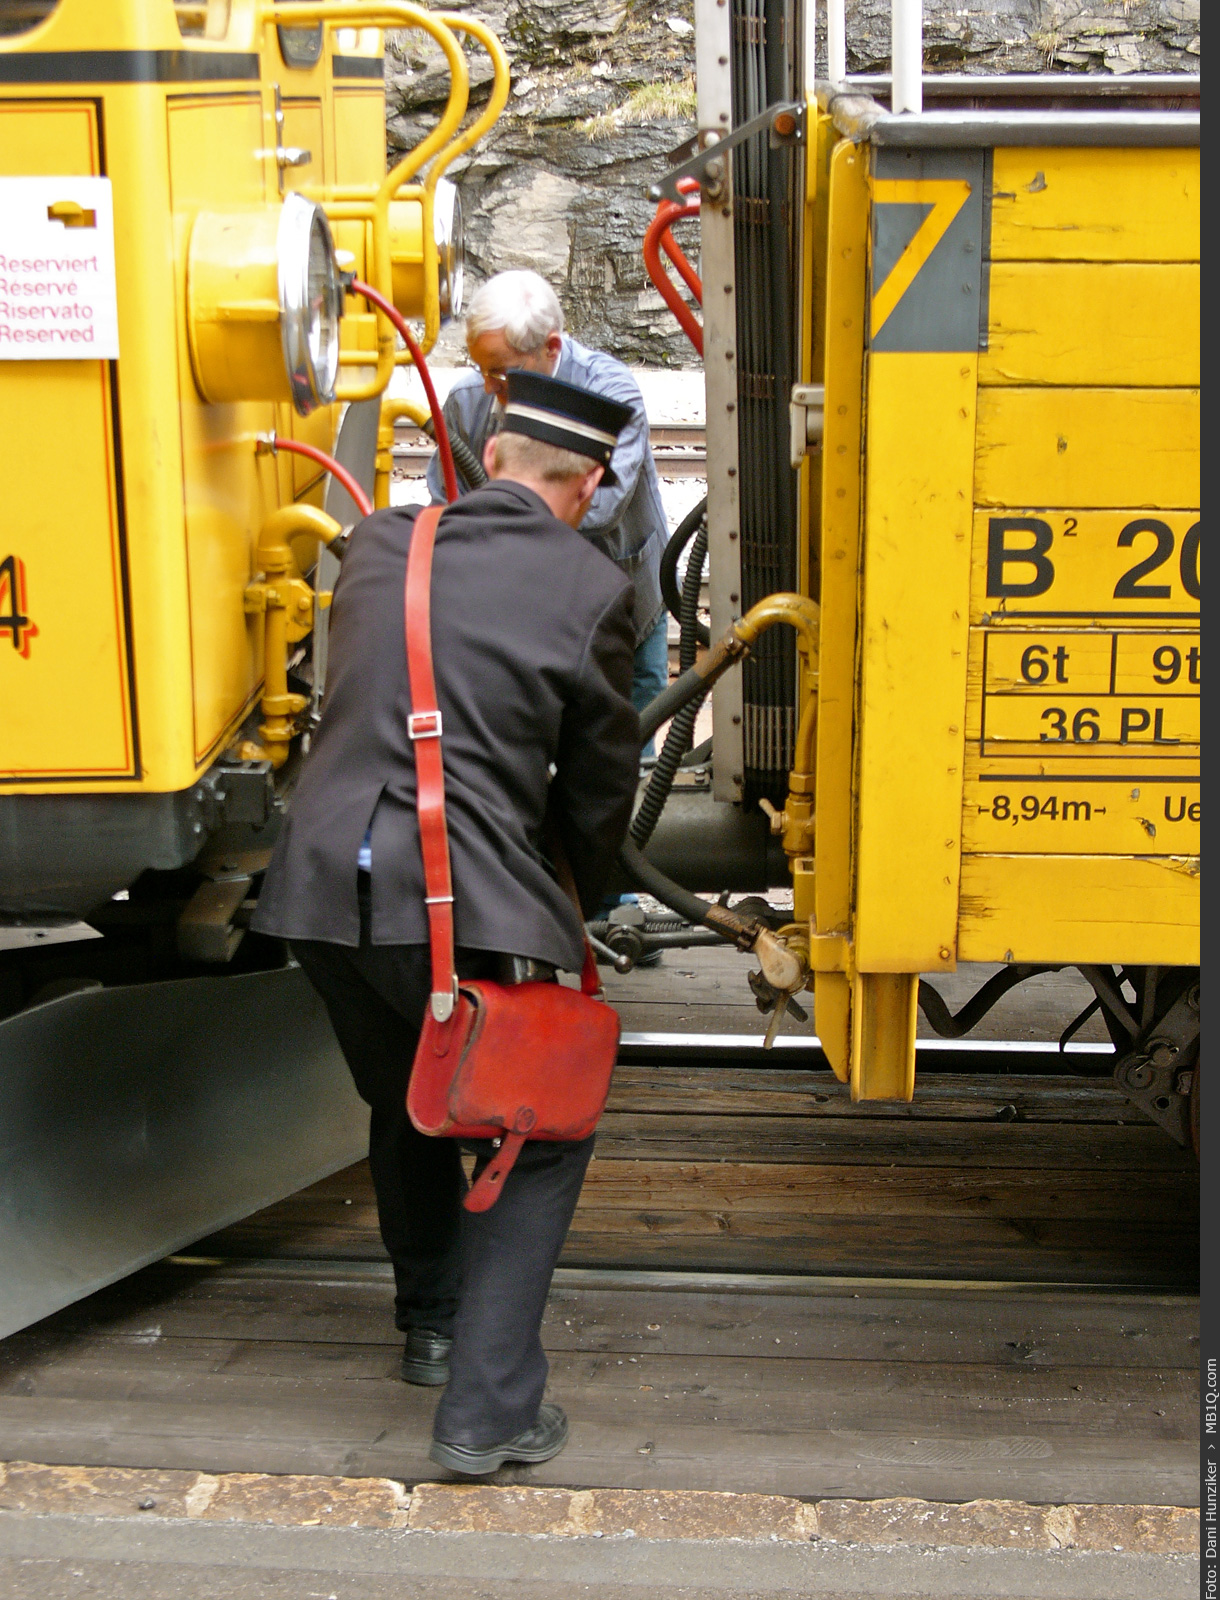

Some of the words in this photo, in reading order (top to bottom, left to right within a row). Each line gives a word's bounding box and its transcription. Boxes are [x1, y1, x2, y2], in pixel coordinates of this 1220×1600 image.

[0, 301, 93, 320] Riservato
[0, 324, 95, 343] Reserved
[1020, 644, 1070, 684] 6t
[1152, 645, 1200, 685] 9t
[1040, 707, 1101, 743] 36
[1120, 708, 1180, 745] PL
